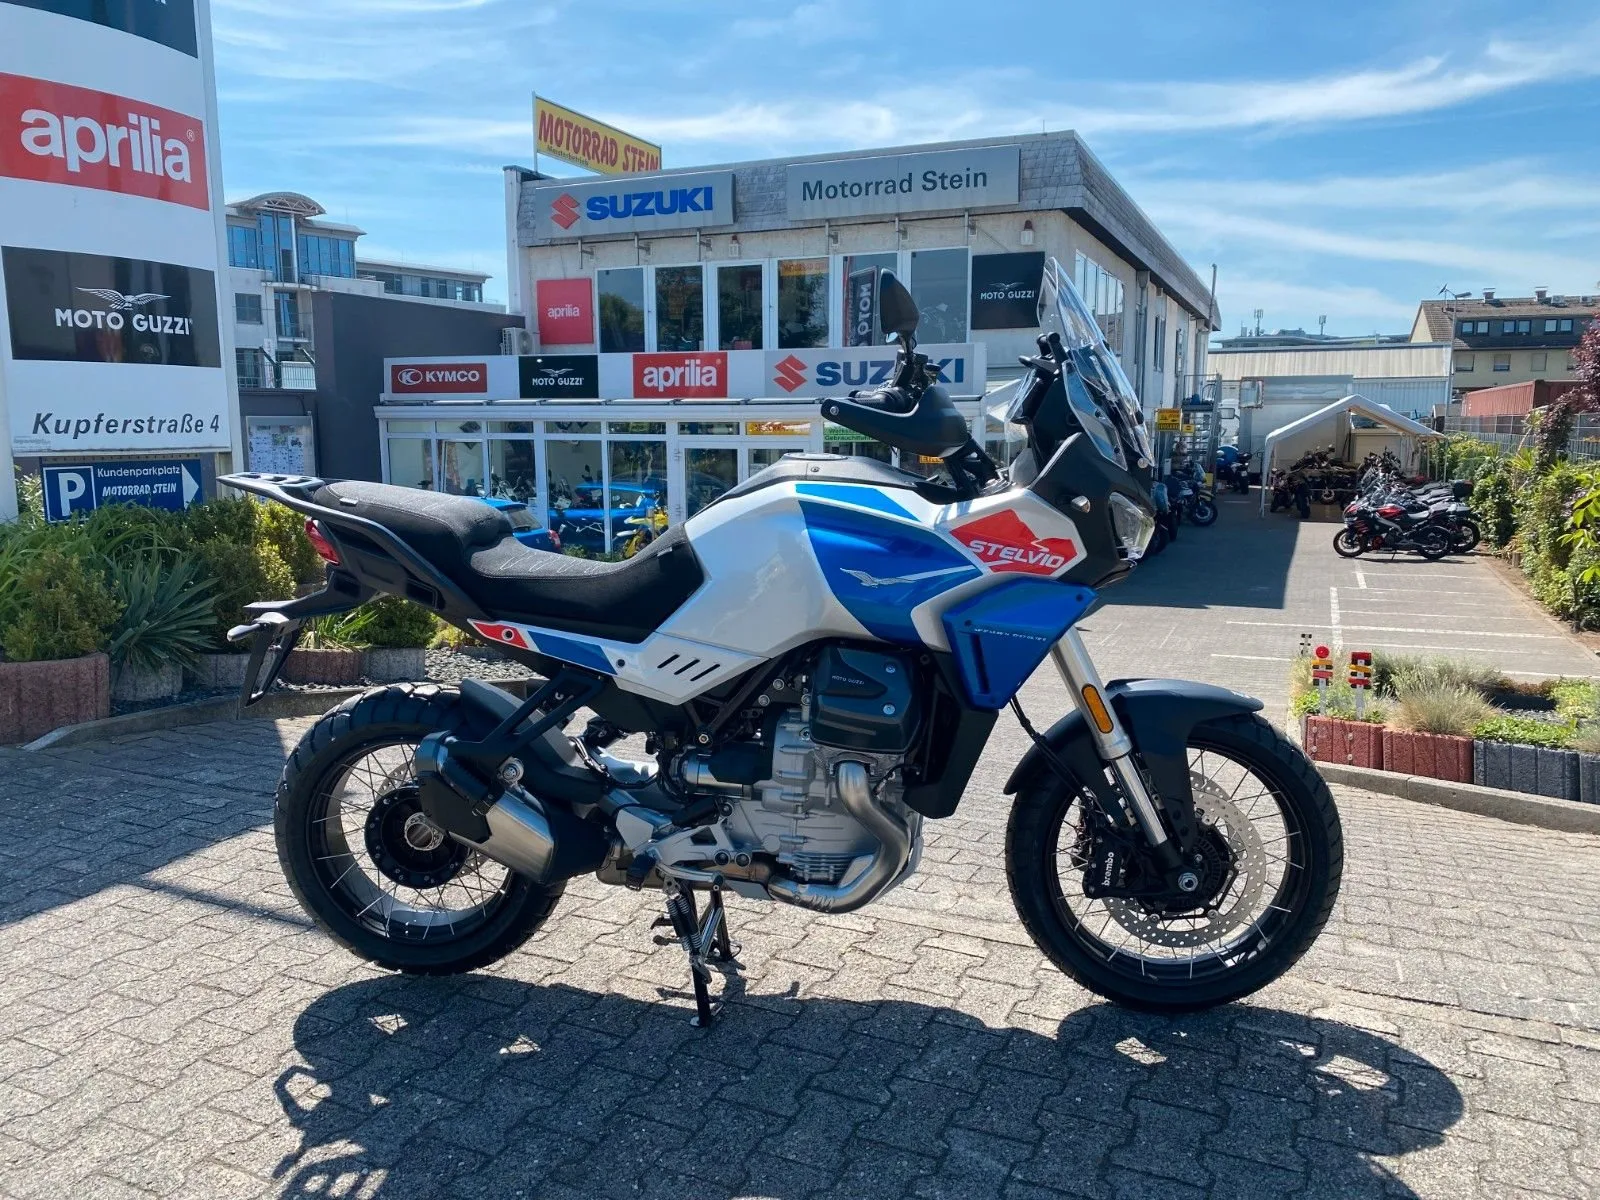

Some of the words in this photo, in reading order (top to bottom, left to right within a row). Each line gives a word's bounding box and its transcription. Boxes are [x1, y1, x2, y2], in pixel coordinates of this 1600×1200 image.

[20, 108, 192, 183] aprilia
[538, 110, 619, 167] MOTORRAD
[622, 144, 659, 172] STEIN
[802, 173, 913, 201] Motorrad
[921, 168, 988, 191] Stein
[586, 186, 713, 221] SUZUKI
[981, 291, 1005, 300] MOTO
[1008, 290, 1035, 299] GUZZI
[54, 308, 125, 330] MOTO
[132, 313, 191, 336] GUZZI
[547, 304, 580, 320] aprilia
[426, 370, 480, 383] KYMCO
[532, 377, 555, 386] MOTO
[557, 377, 583, 386] GUZZI
[643, 359, 717, 392] aprilia
[815, 358, 965, 386] SUZKI
[32, 412, 204, 440] Kupferstraße
[210, 414, 220, 433] 4
[97, 465, 180, 478] Kundenparkplatz
[58, 472, 86, 517] P
[102, 485, 151, 497] MOTORRAD
[152, 483, 177, 494] STEIN
[969, 539, 1065, 569] STELVIO
[1101, 851, 1115, 887] brembo
